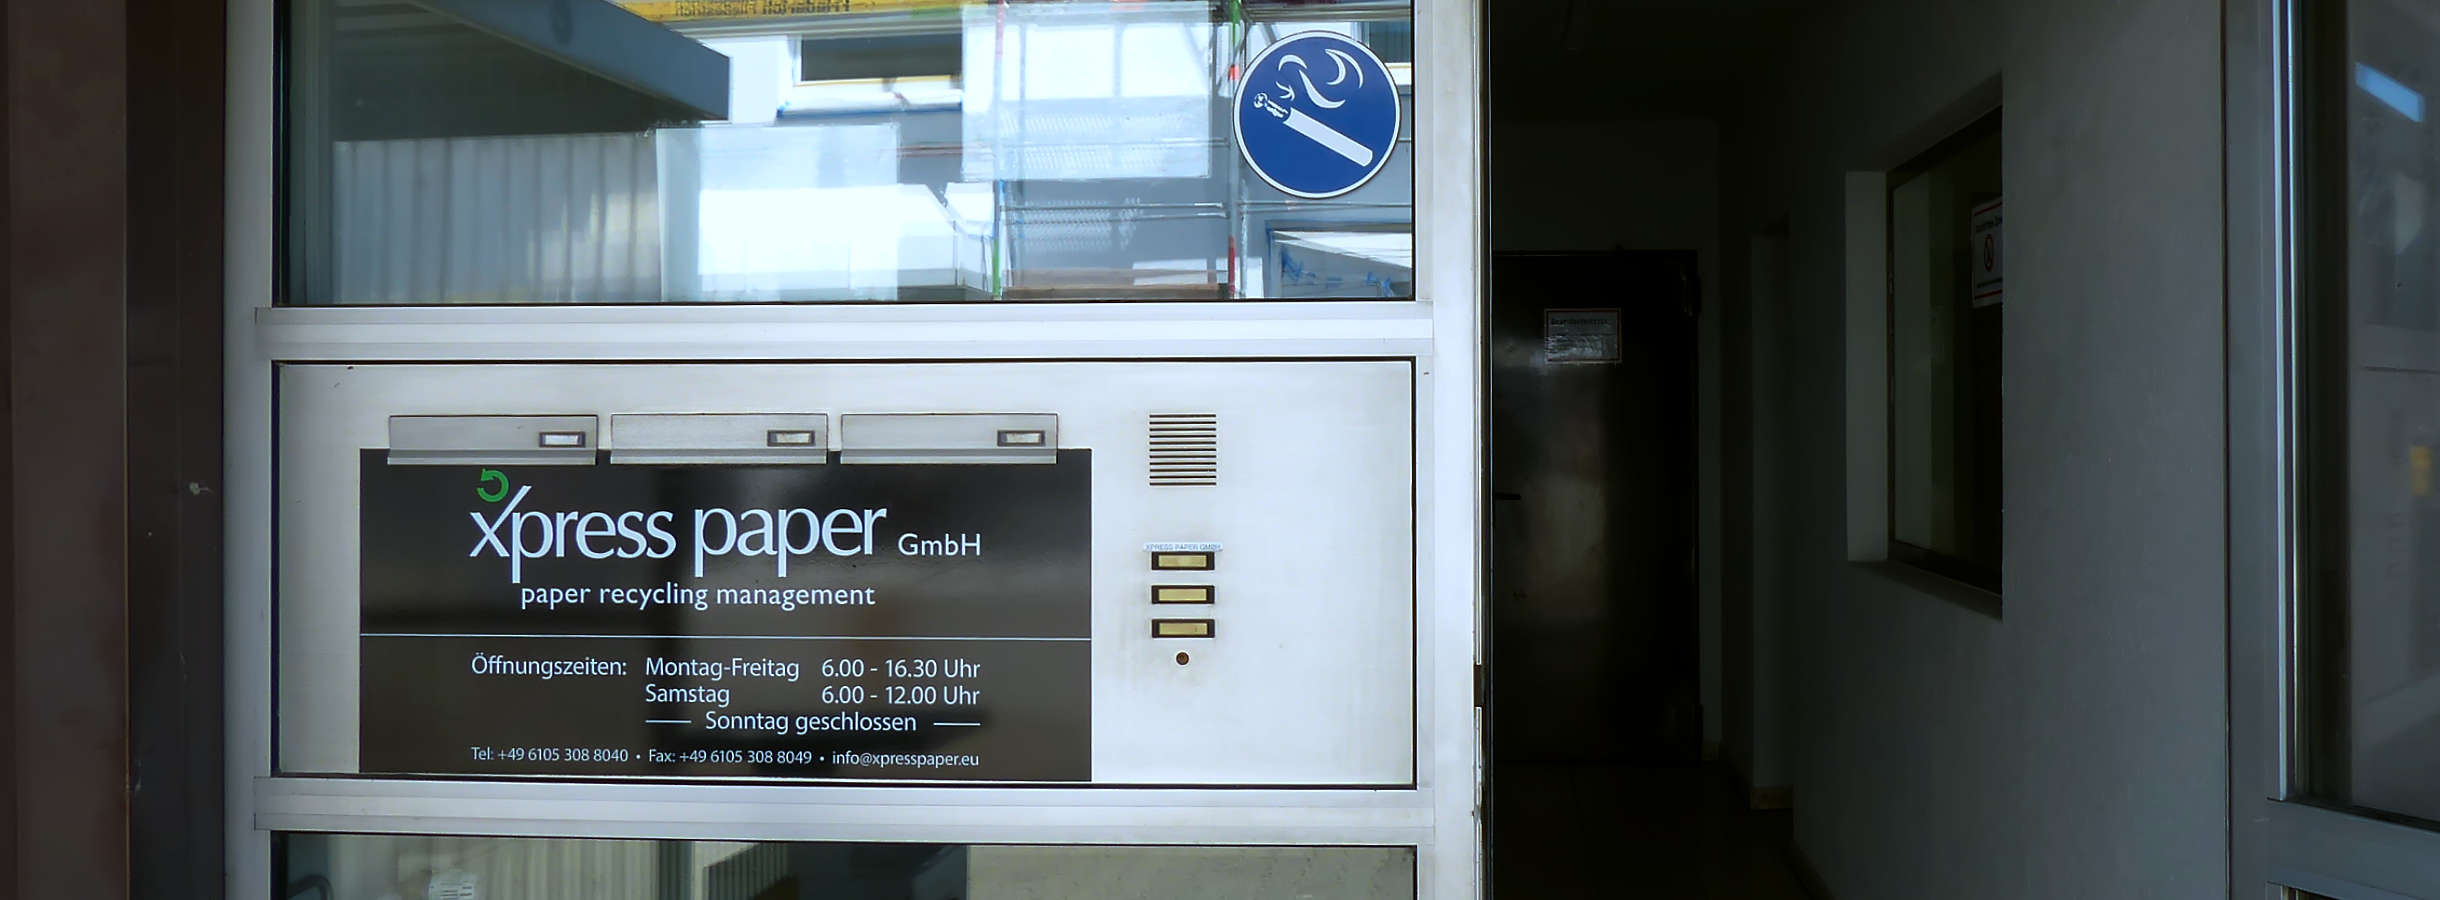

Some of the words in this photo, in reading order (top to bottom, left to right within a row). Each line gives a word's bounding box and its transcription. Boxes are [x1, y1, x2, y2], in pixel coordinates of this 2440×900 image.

[469, 485, 677, 583] xpress
[694, 507, 888, 577] paper
[898, 532, 981, 557] GmbH
[520, 583, 591, 610] paper
[600, 582, 708, 612] recycling
[716, 587, 876, 612] management
[471, 651, 627, 680] Öffnungszeiten:
[645, 657, 800, 681] Montag-Freitag
[821, 658, 865, 678] 6.00
[885, 659, 938, 678] 16.30
[944, 657, 981, 679] Uhr
[645, 683, 730, 708] Samstag
[821, 685, 865, 705] 6.00
[885, 685, 937, 705] 12.00
[943, 684, 981, 705] Uhr
[705, 710, 789, 734] Sonntag
[795, 711, 917, 735] geschlossen
[471, 746, 494, 761] Tel:
[498, 747, 525, 761] +49
[528, 747, 560, 762] 6105
[564, 748, 590, 762] 308
[593, 748, 629, 762] 8040
[648, 748, 676, 763] Fax:
[679, 749, 707, 763] +49
[710, 749, 743, 764] 6105
[747, 750, 774, 764] 308
[776, 750, 813, 765] 8049
[832, 749, 980, 769] info@xpresspaper.eu
